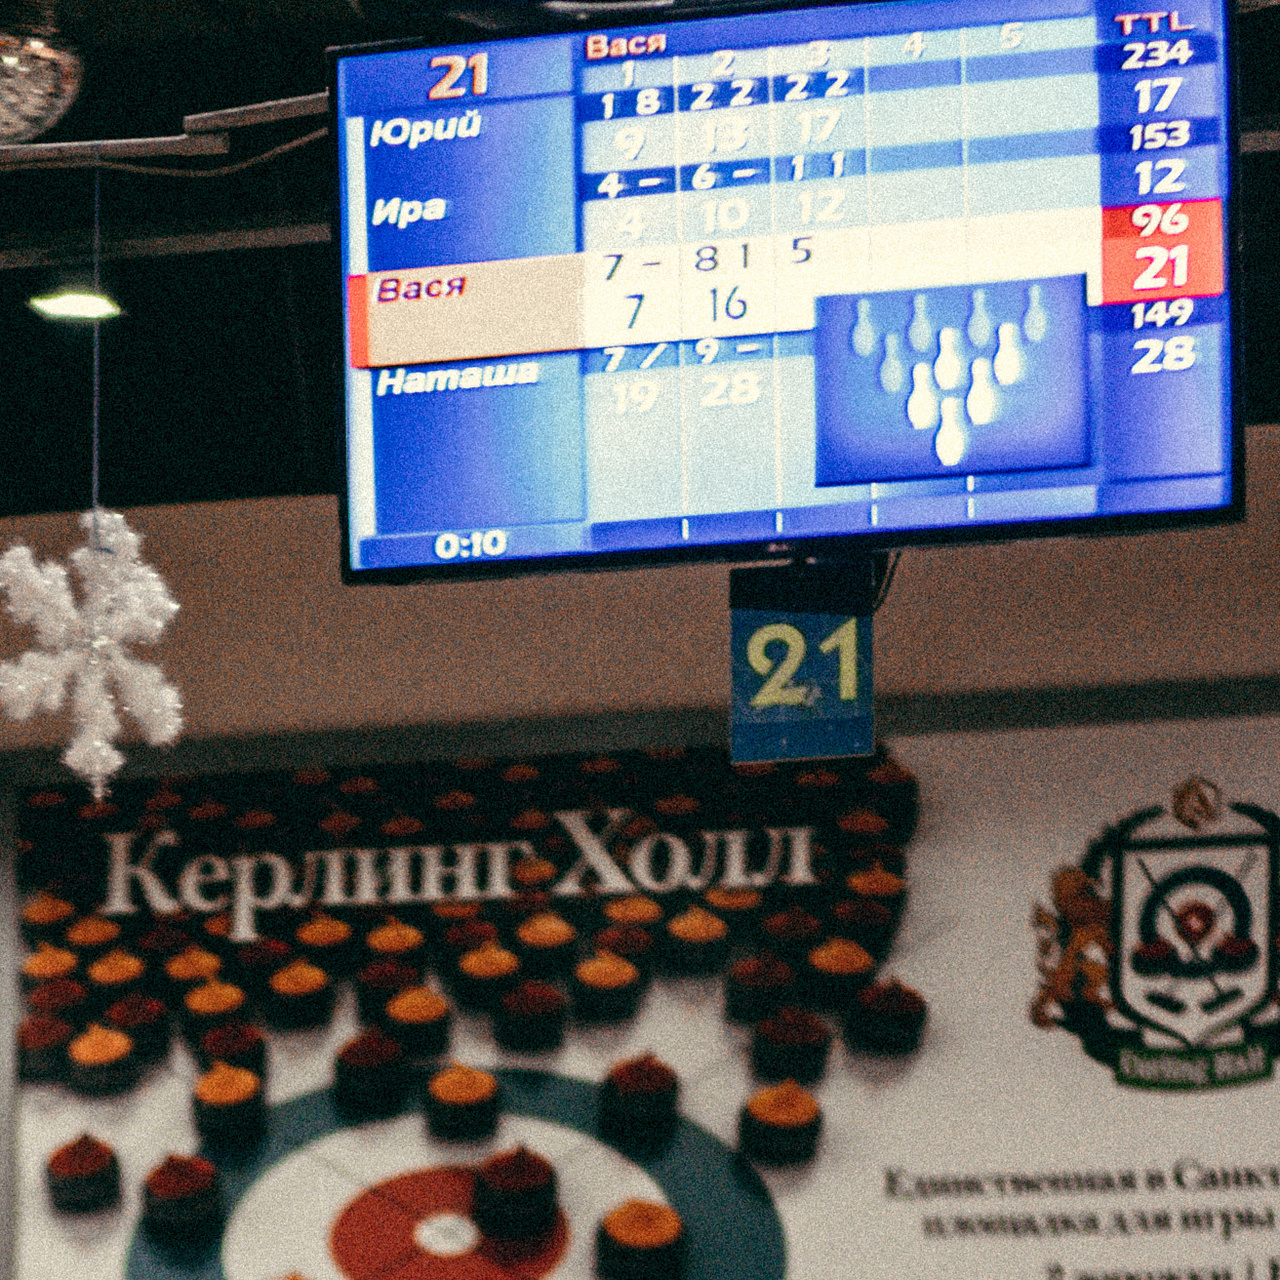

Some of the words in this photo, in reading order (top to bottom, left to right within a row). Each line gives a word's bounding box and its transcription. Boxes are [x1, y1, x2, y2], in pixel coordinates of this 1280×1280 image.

[1115, 12, 1193, 36] TTL
[585, 33, 667, 60] Вася
[1122, 38, 1194, 70] 234
[428, 52, 489, 101] 21
[621, 60, 636, 87] 1
[601, 93, 615, 120] 1
[636, 88, 660, 116] 8
[691, 83, 715, 112] 2
[730, 79, 754, 107] 2
[785, 74, 809, 102] 2
[825, 69, 850, 97] 2
[1133, 76, 1184, 113] 17
[370, 109, 482, 150] Юрий
[614, 125, 646, 161] 9
[799, 109, 842, 143] 17
[1129, 119, 1191, 151] 153
[597, 172, 623, 198] 4
[692, 163, 715, 191] 6
[1133, 159, 1187, 195] 12
[372, 197, 447, 229] Ира
[703, 198, 750, 233] 10
[799, 190, 844, 224] 12
[1131, 203, 1190, 237] 96
[602, 253, 625, 282] 7
[693, 244, 719, 273] 8
[791, 237, 813, 264] 5
[1133, 245, 1189, 290] 21
[376, 274, 468, 304] Вася
[626, 293, 646, 330] 7
[709, 285, 749, 322] 16
[1131, 298, 1195, 329] 149
[695, 337, 719, 366] 9
[1131, 336, 1196, 375] 28
[377, 361, 540, 396] Наташа
[613, 378, 660, 415] 19
[702, 371, 762, 407] 28
[435, 529, 508, 560] 0:10
[747, 616, 857, 707] 21
[101, 828, 536, 942] Керлинг
[551, 807, 819, 896] Холл
[884, 1164, 1137, 1201] Единственная
[922, 1208, 1100, 1240] площадка
[1179, 1204, 1276, 1243] игры
